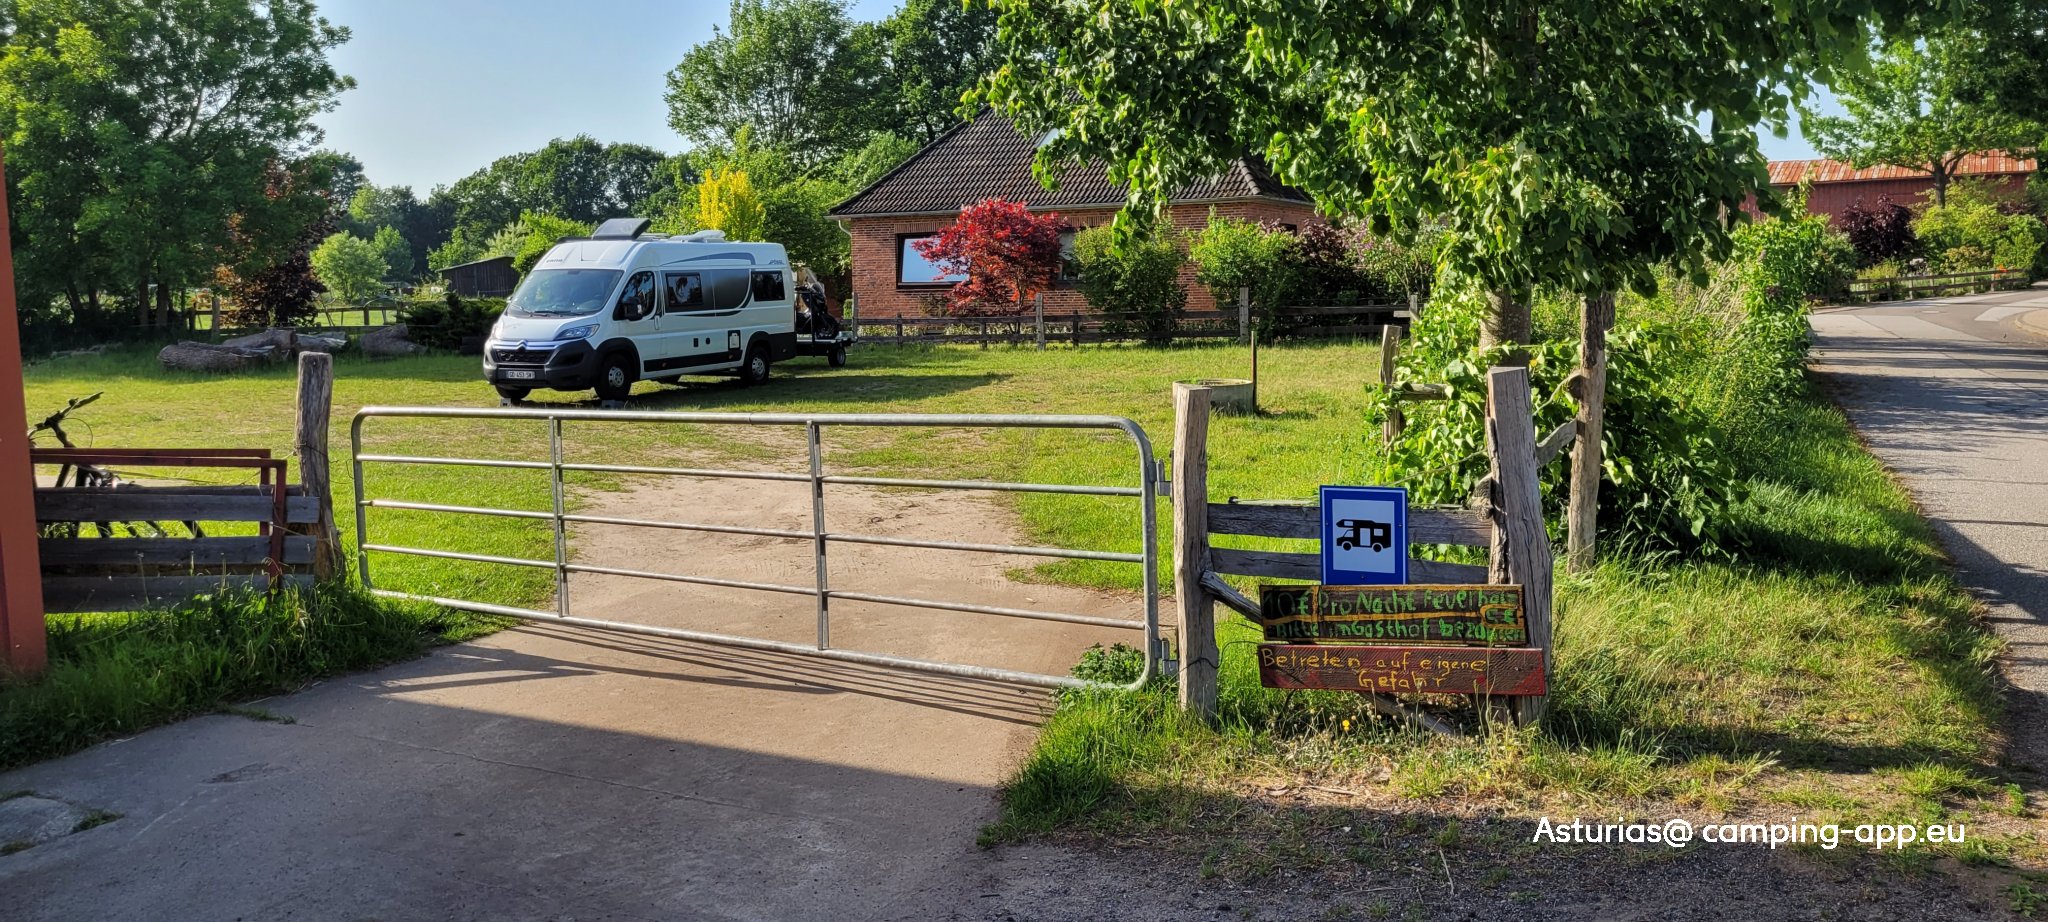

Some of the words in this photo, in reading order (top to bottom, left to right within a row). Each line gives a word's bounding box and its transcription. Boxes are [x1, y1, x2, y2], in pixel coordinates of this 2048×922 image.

[1356, 588, 1416, 616] Nacht
[1261, 648, 1360, 667] Betreten
[1376, 652, 1411, 672] auf
[1419, 656, 1486, 677] eigene
[1358, 670, 1446, 690] Gefahr
